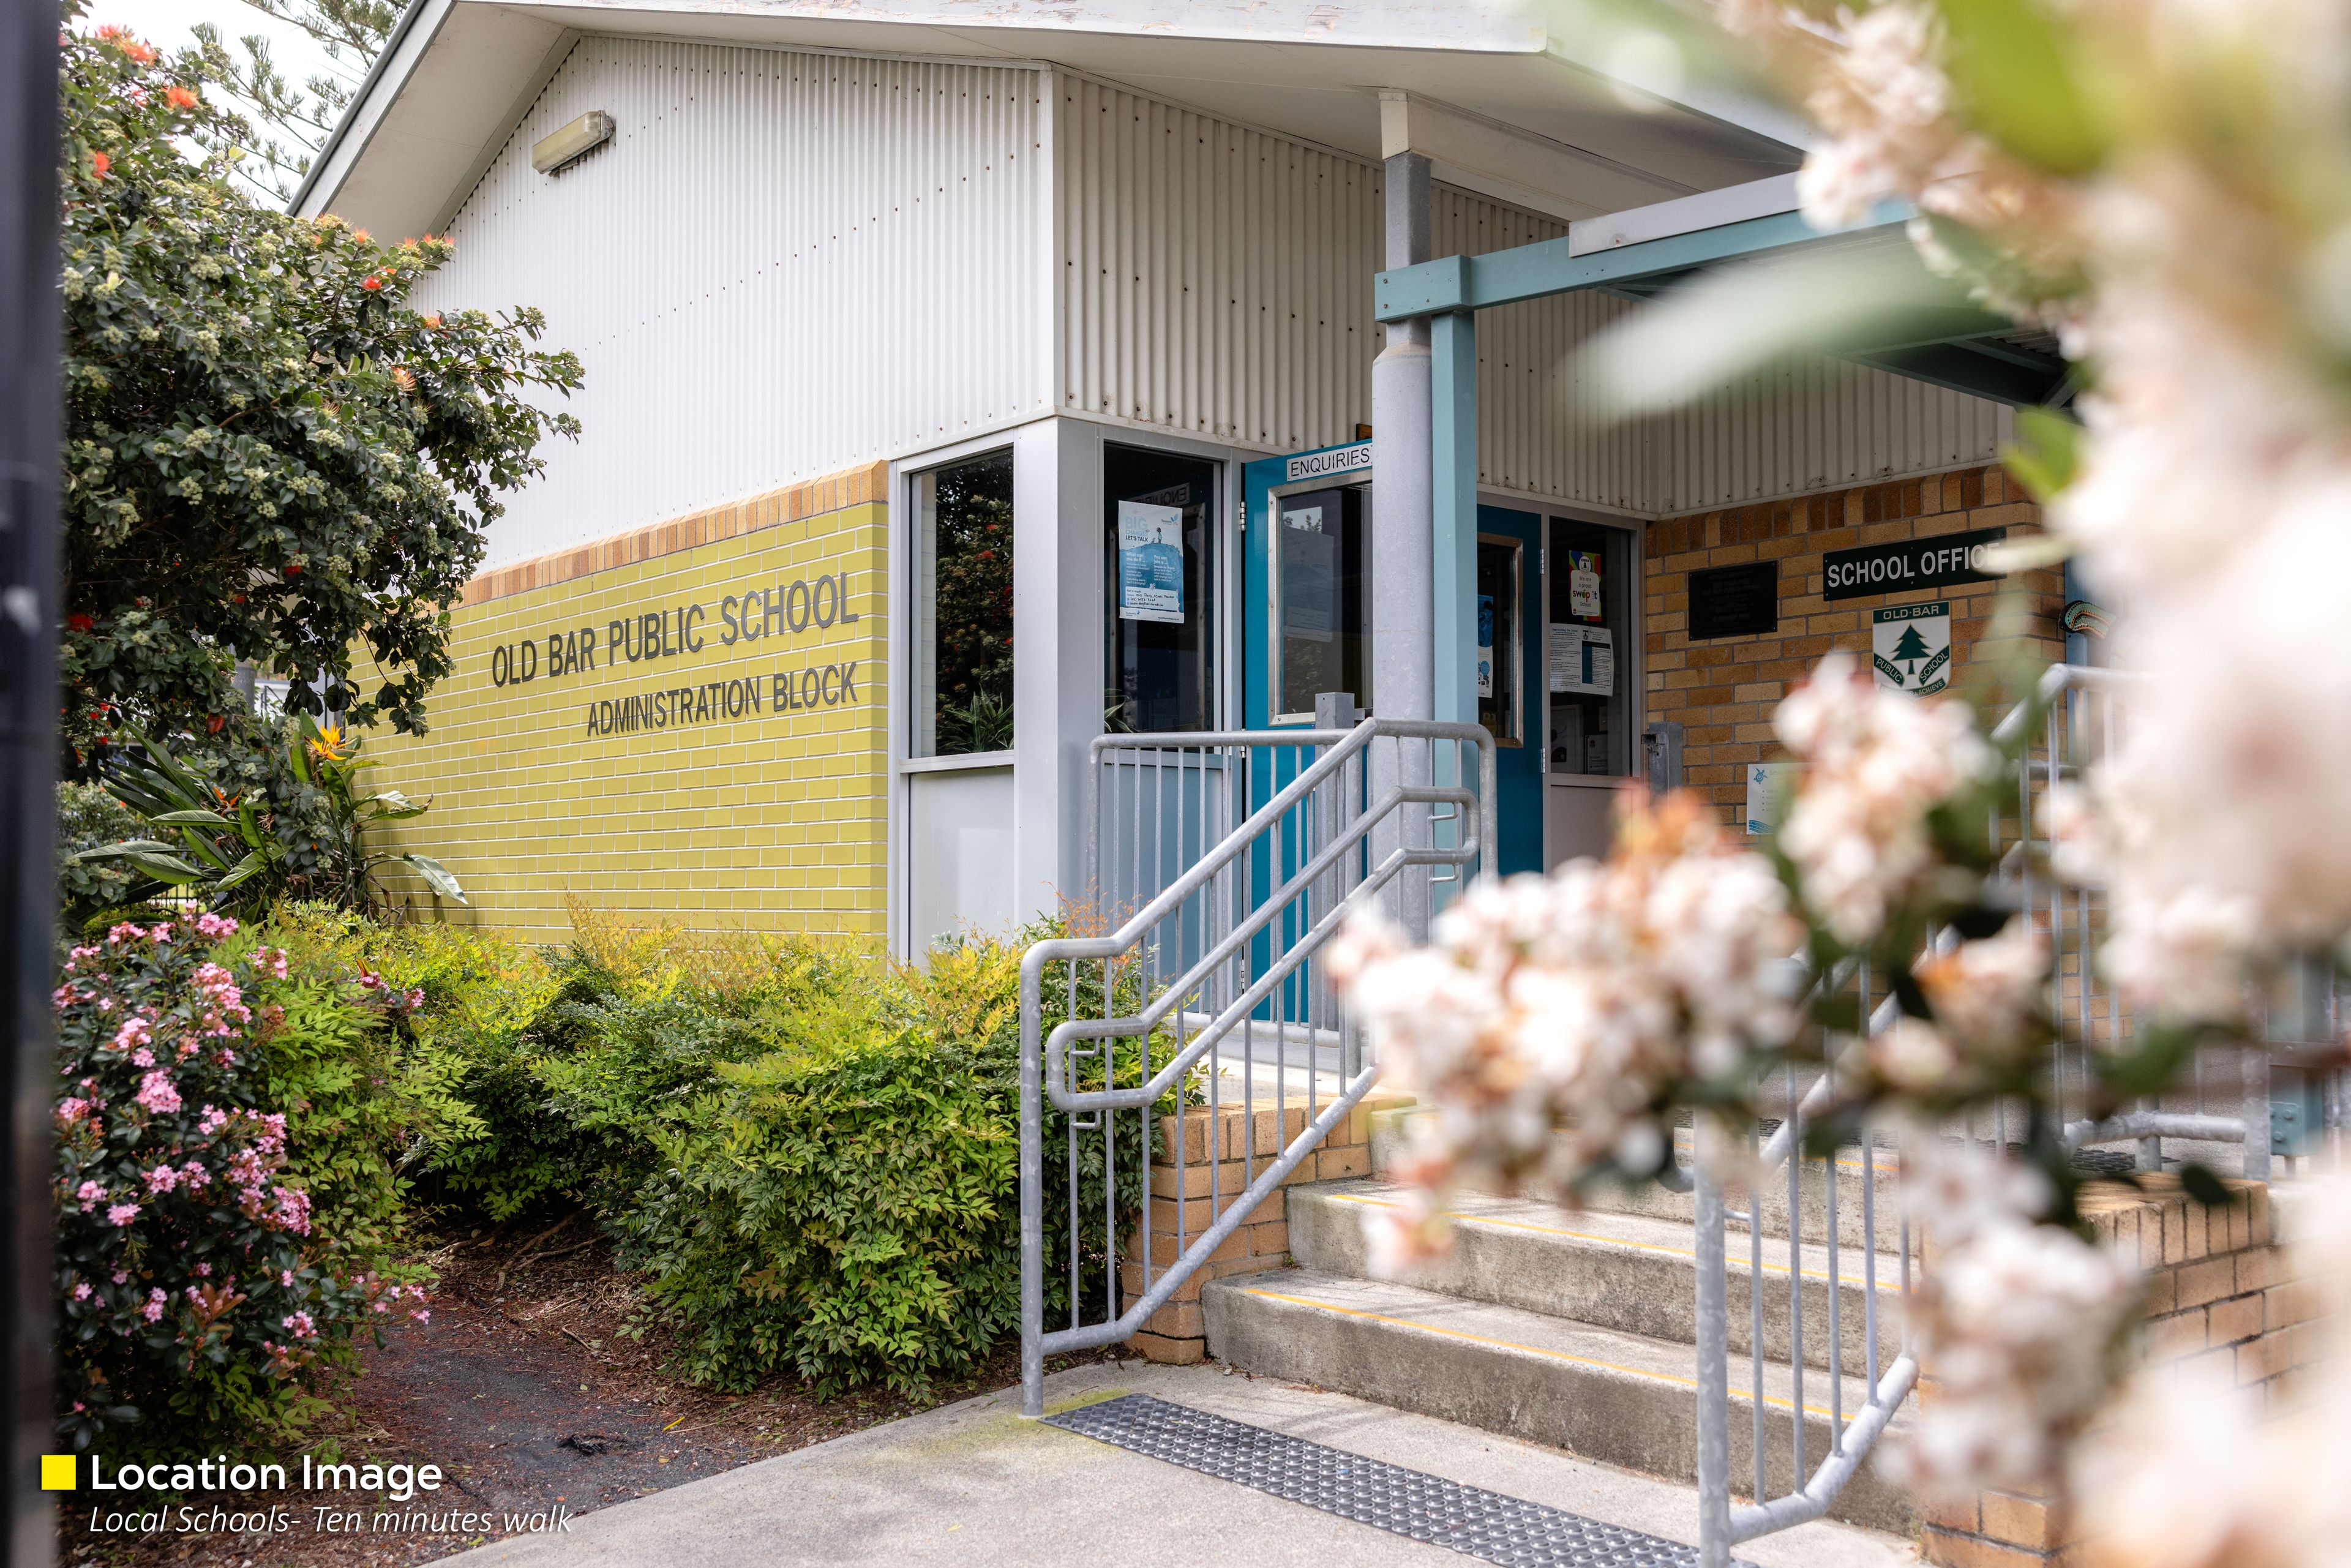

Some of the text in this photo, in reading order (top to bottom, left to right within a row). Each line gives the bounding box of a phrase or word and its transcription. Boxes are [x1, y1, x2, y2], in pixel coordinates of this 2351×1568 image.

[1291, 448, 1370, 477] ENQUIRIES
[1125, 516, 1148, 530] BIG
[1828, 555, 1915, 588] SCHOOL
[492, 571, 858, 688] OLD BAR PUBLIC SCHOOL
[1875, 658, 1903, 682] PUBLIC
[1919, 651, 1949, 681] SCHOOL
[587, 662, 858, 736] ADMINISTRATION BLOCK
[1918, 680, 1944, 696] ACHIEVE
